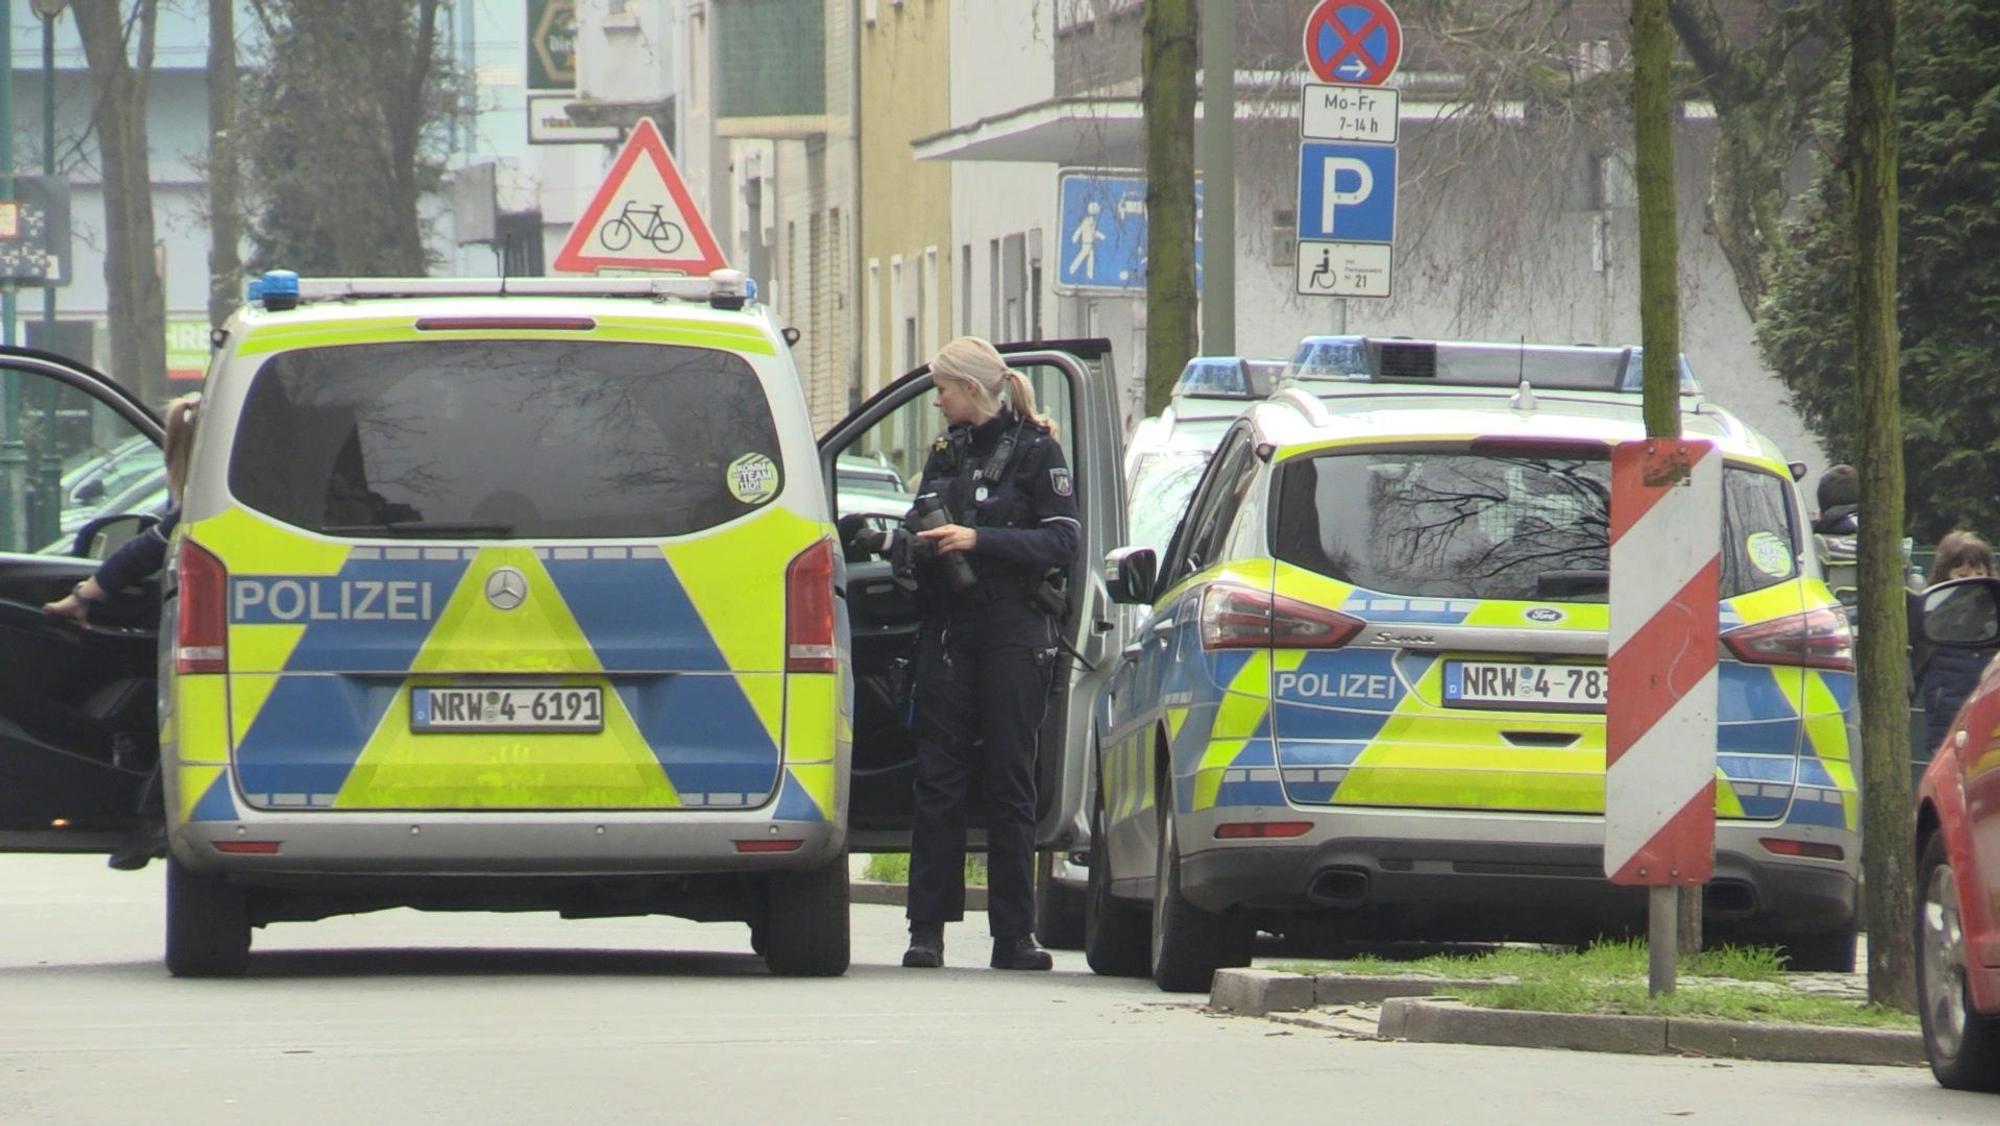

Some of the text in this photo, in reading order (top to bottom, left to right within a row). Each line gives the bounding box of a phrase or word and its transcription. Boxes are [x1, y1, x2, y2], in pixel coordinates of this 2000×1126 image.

[1324, 94, 1376, 112] Mo-Fr
[1340, 116, 1378, 133] 7-14 h
[1322, 156, 1374, 234] P
[1355, 274, 1367, 289] 21
[234, 580, 433, 620] POLIZEI
[1530, 607, 1560, 622] Ford
[1278, 672, 1396, 699] POLIZEI
[1463, 666, 1517, 697] NRW
[430, 691, 600, 721] NRW 4-6191
